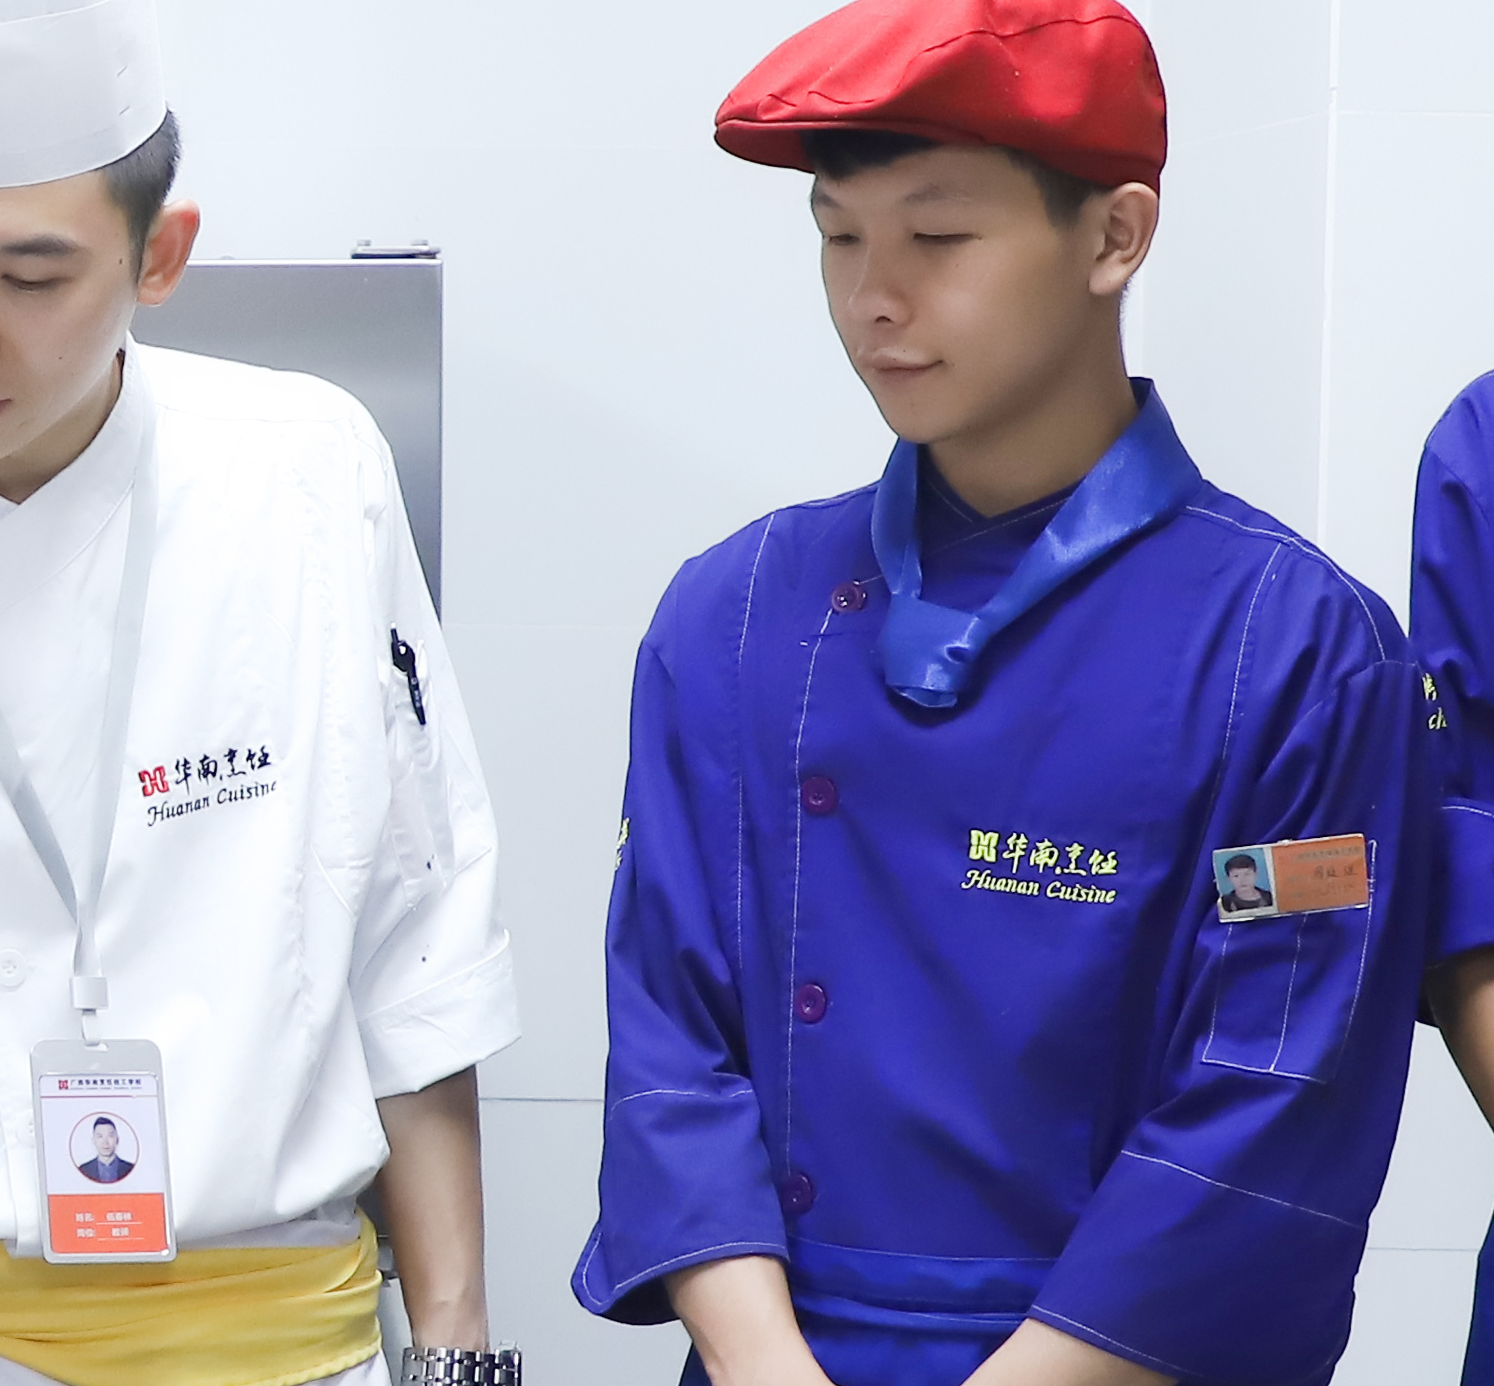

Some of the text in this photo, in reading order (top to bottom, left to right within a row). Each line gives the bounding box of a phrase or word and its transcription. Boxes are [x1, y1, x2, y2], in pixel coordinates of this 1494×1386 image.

[147, 779, 278, 828] Huanan Cuisine
[960, 868, 1118, 905] Huanan Cuisine
